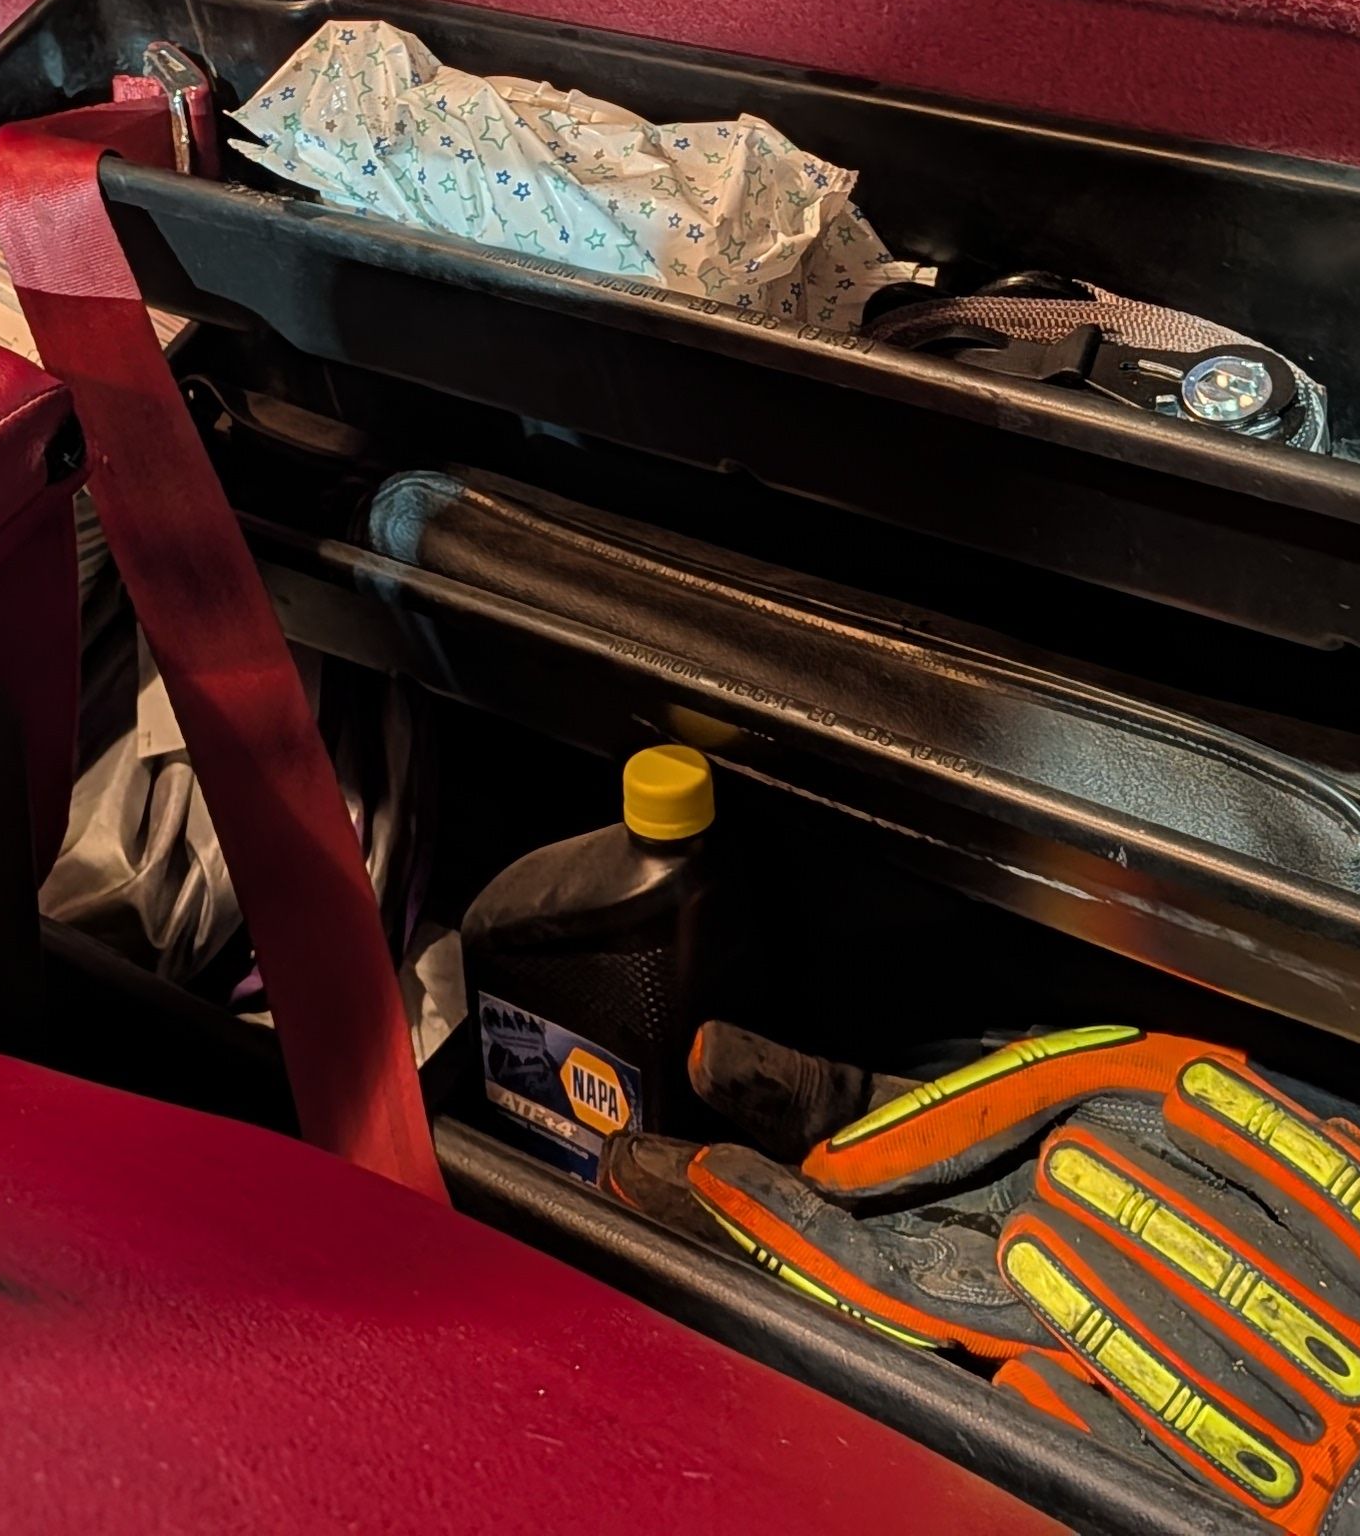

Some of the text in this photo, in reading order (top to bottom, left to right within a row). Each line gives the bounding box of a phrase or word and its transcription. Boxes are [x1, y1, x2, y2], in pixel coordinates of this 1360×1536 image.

[480, 248, 579, 280] MAXIMUM
[608, 639, 705, 679] MAXIMUM
[718, 677, 794, 710] WEIGHT
[572, 1066, 620, 1122] NAPA
